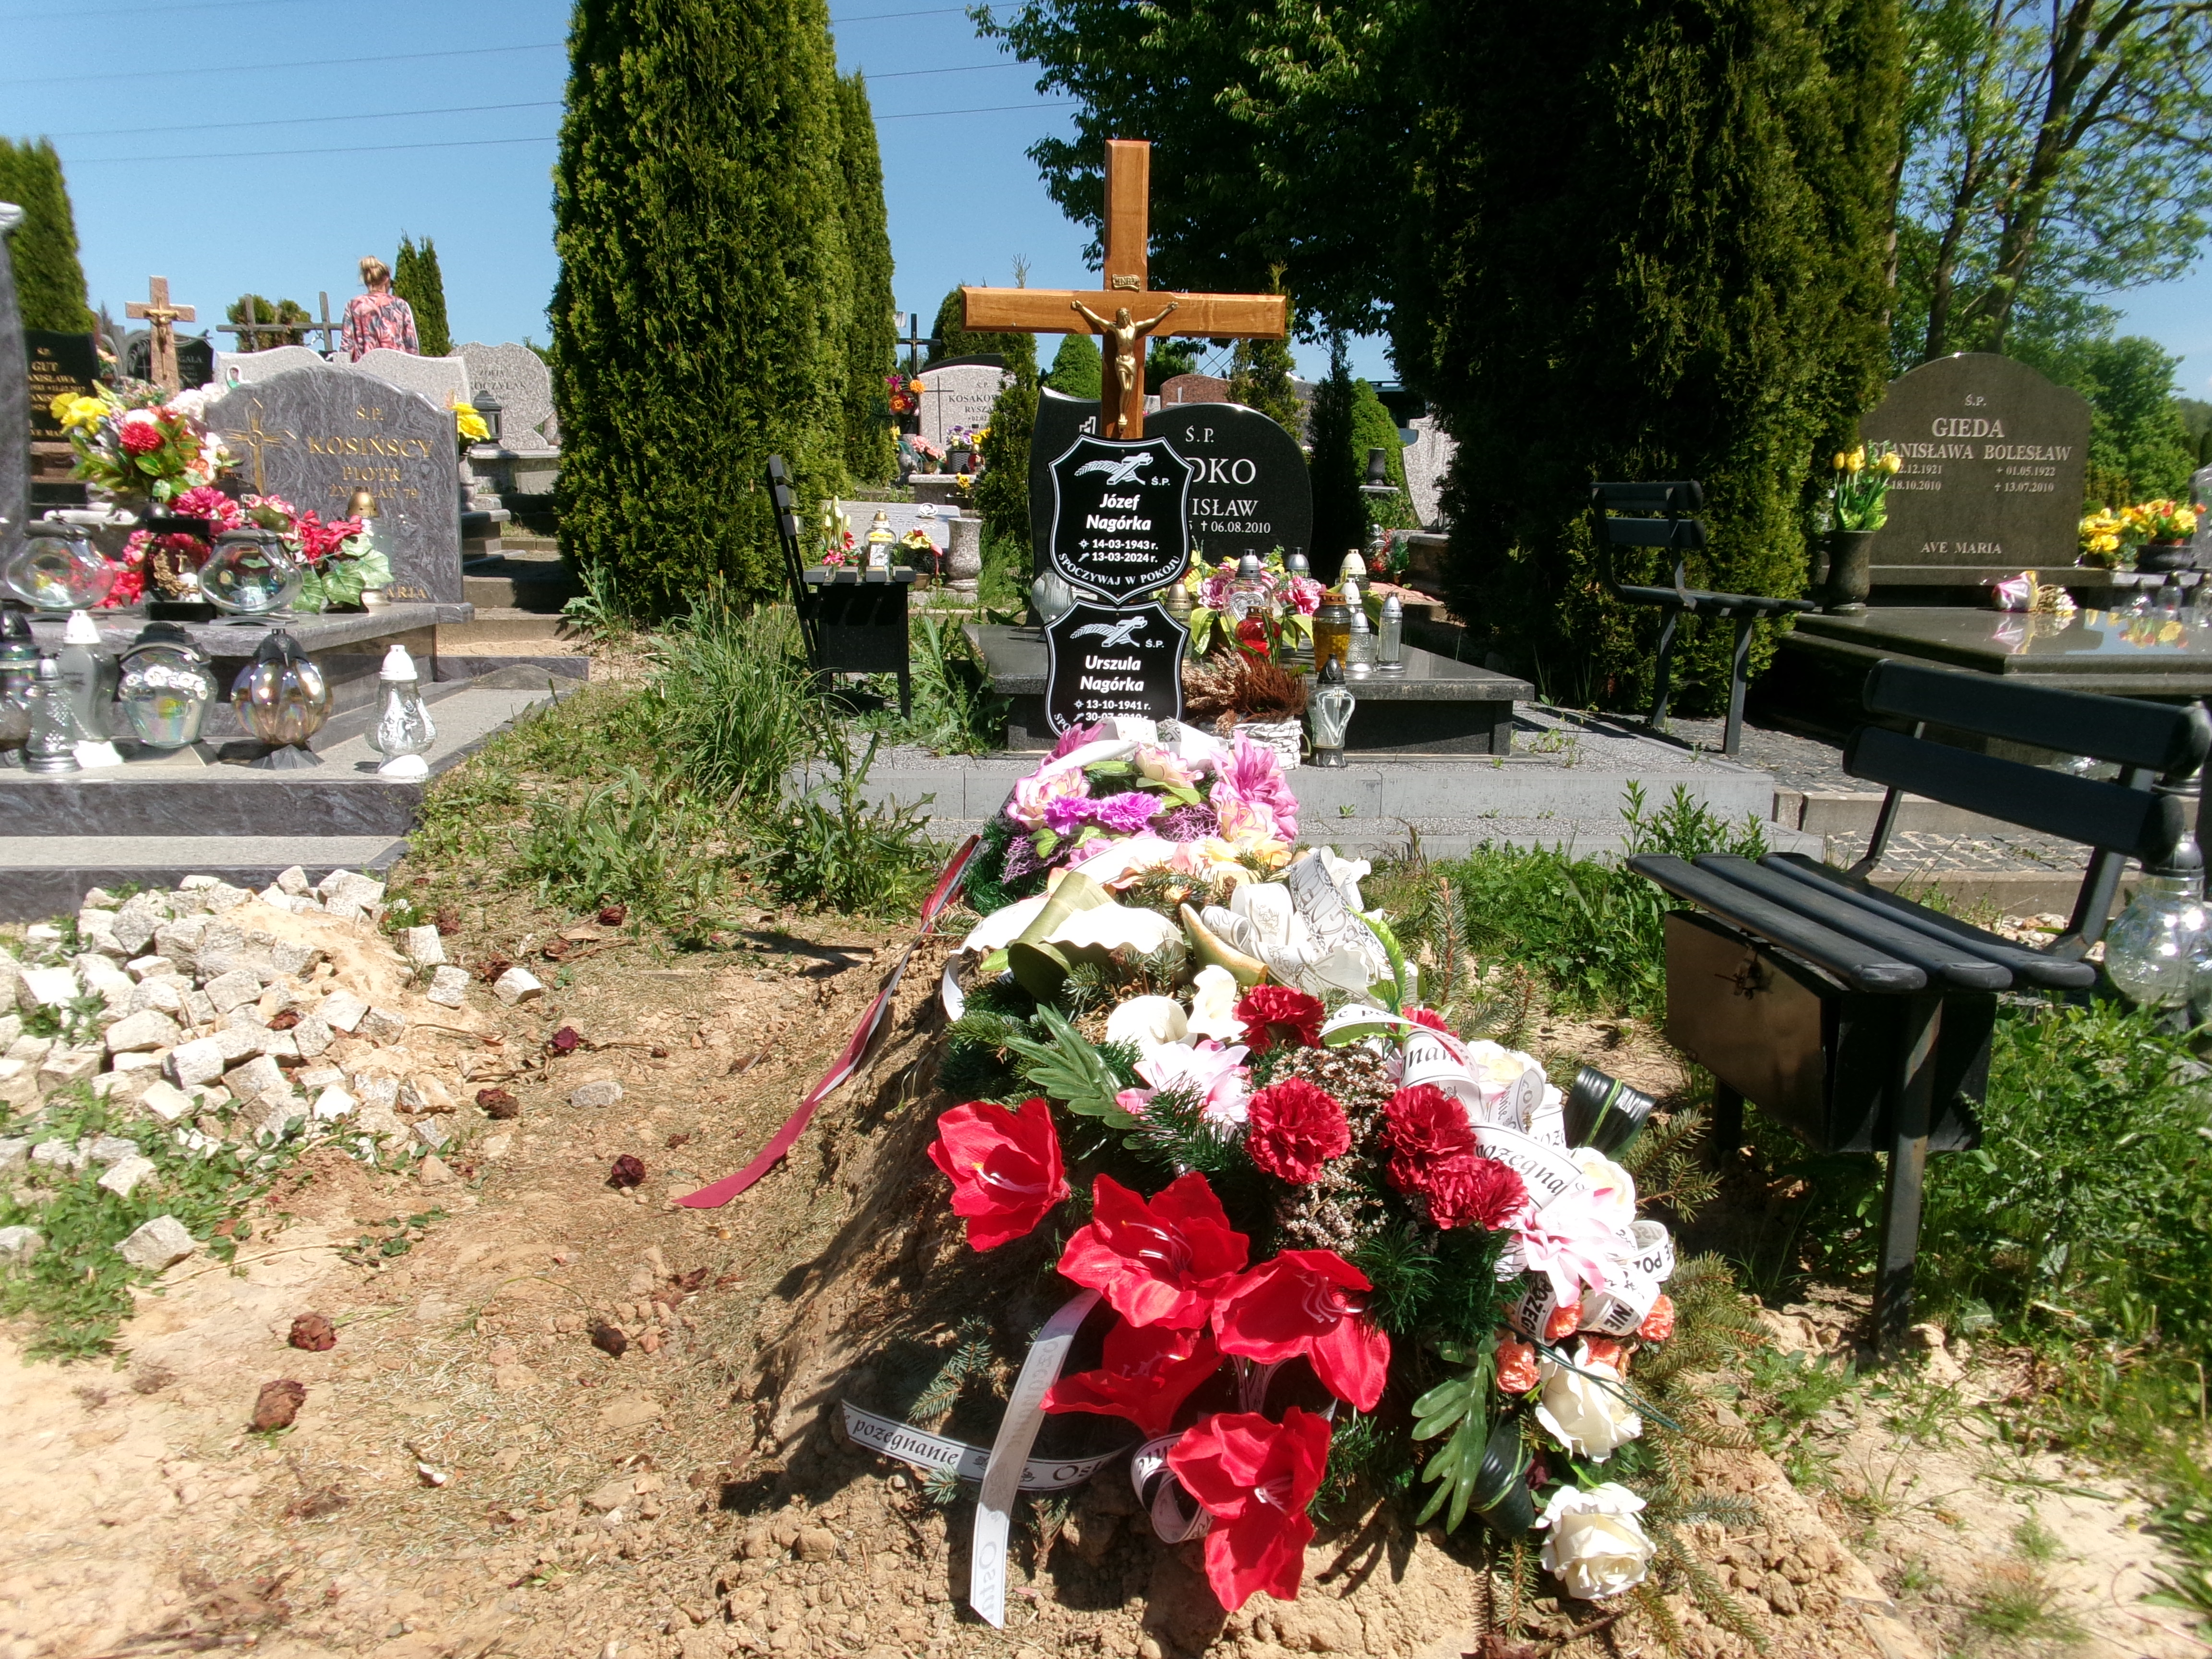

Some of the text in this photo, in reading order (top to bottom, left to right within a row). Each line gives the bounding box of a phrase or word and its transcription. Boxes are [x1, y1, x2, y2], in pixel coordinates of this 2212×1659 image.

[949, 394, 998, 403] KOSAKOW
[1932, 418, 2005, 438] GIEDA
[308, 433, 433, 457] KOSIŃSCY
[1984, 445, 2073, 461] BOLESŁAW
[343, 467, 401, 482] PIOTR
[1184, 457, 1256, 485] DKO
[1897, 464, 2056, 476] 2.12.1921 01.05.1922
[1151, 476, 1171, 486] Ś.P.
[2004, 481, 2054, 493] 13.07.2010
[1099, 493, 1141, 511] Józef
[1191, 498, 1259, 517] ISŁAW
[1086, 514, 1152, 533] Nagórka
[1211, 521, 1271, 533] 06.08.2010
[1092, 539, 1150, 549] 14-03-1943
[1920, 541, 2002, 554] AVE MARIA
[1092, 552, 1149, 563] 13-03-2024
[1058, 553, 1180, 586] SPOCZYWAJ W POKOJU
[385, 586, 428, 599] ARIA
[1145, 638, 1165, 648] Ś.P.
[1085, 655, 1142, 671] Urszula
[1080, 675, 1144, 693] Nagórka
[1086, 699, 1142, 710] 13-10-1941
[1054, 713, 1071, 732] SPO
[852, 1419, 959, 1465] pozegnanie
[1052, 1460, 1103, 1481] Ost
